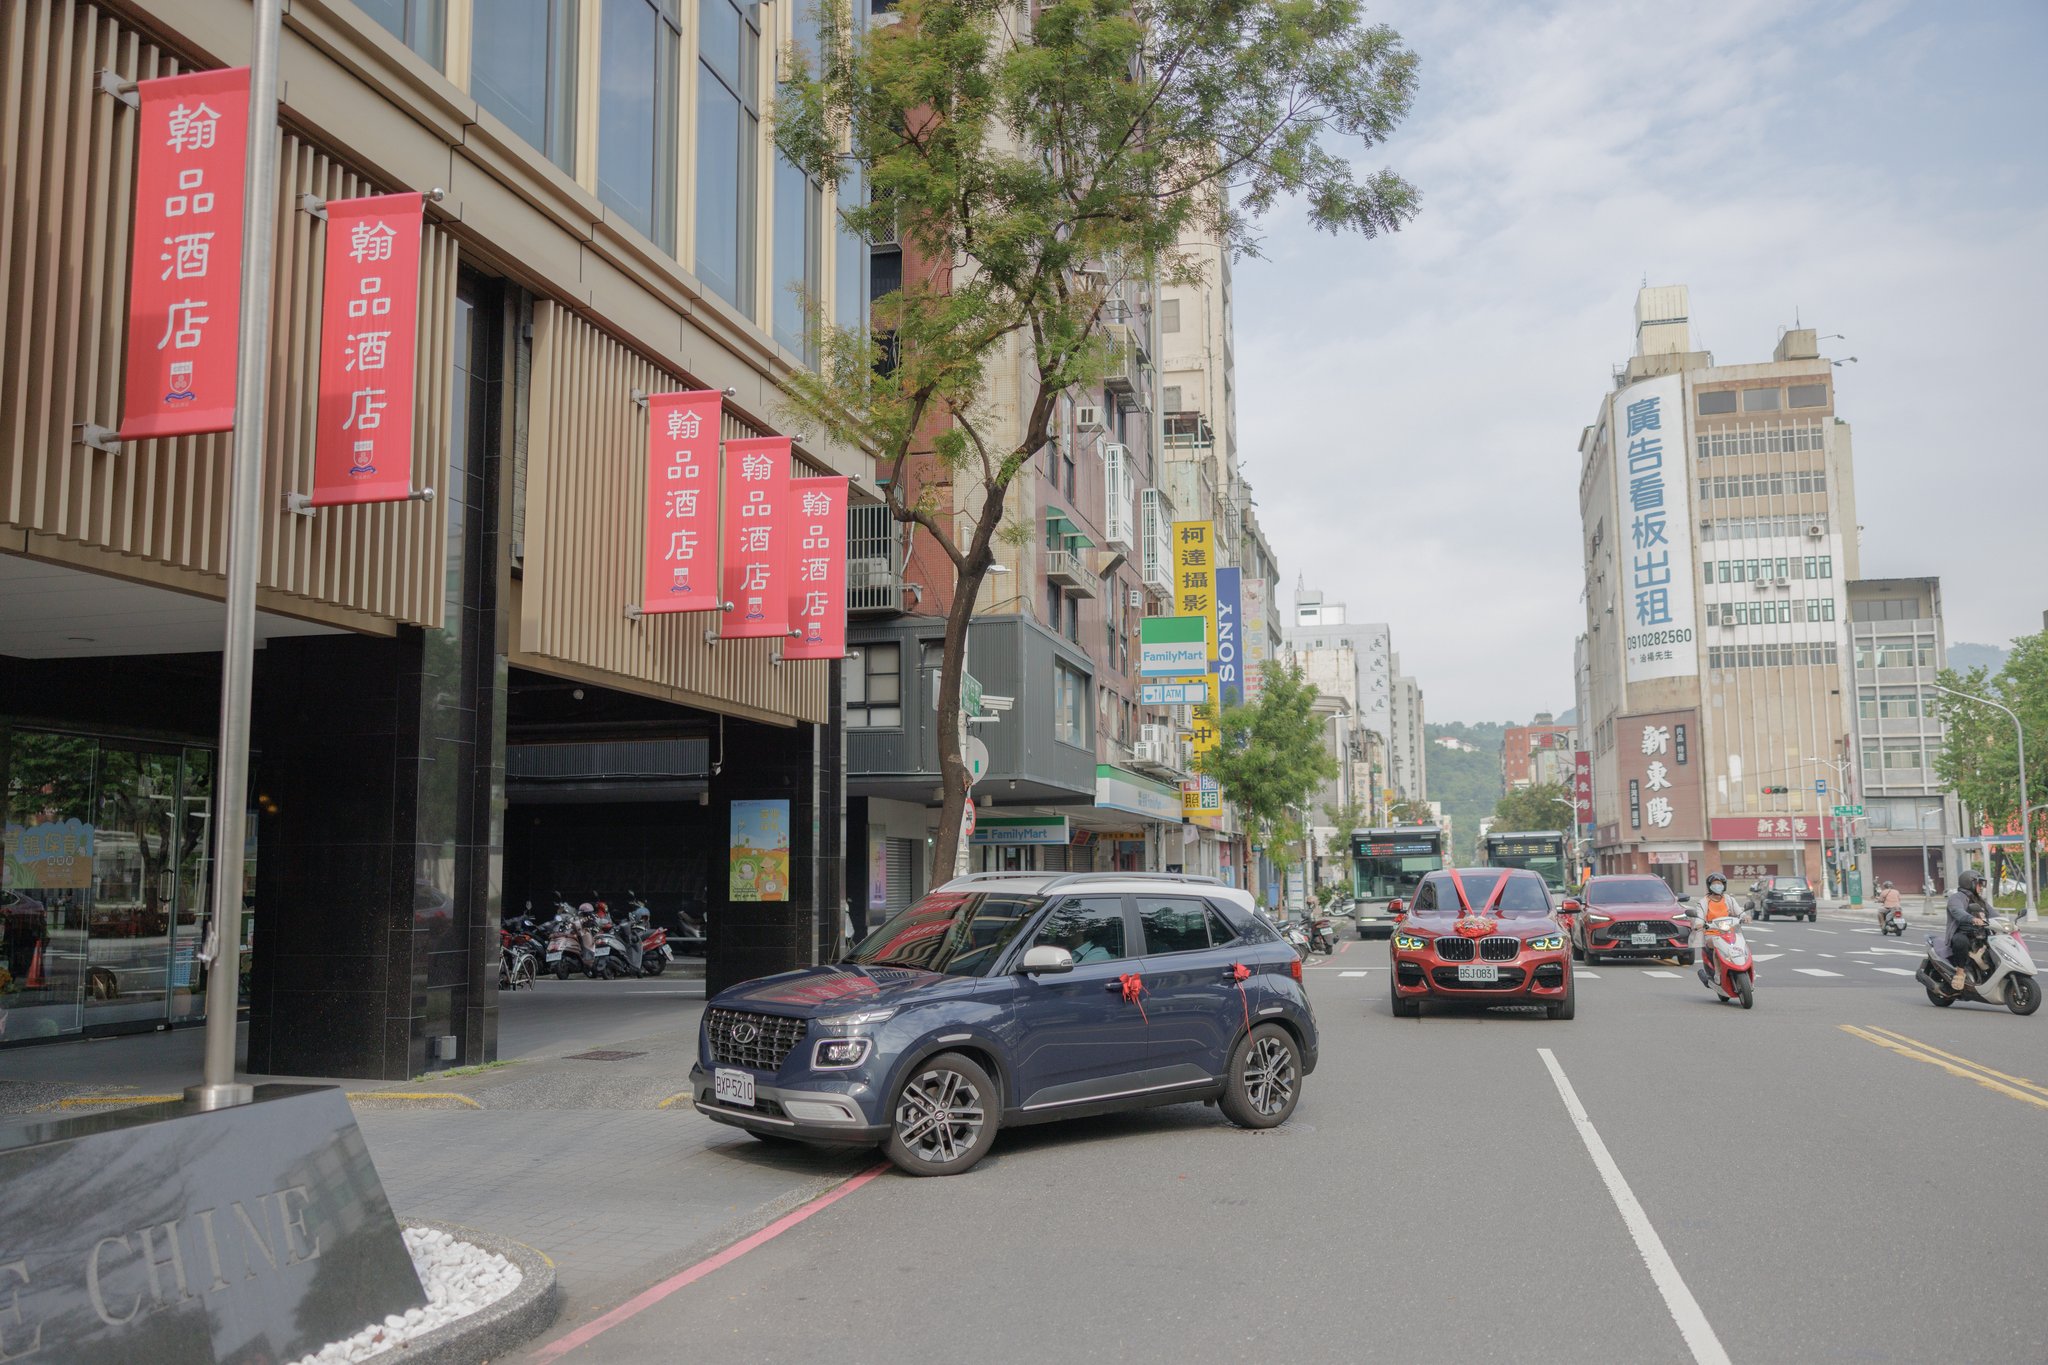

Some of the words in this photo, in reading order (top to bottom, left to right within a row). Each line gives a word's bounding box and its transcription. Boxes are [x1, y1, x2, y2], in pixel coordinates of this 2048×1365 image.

[157, 102, 222, 350] 翰品酒店
[342, 220, 397, 430] 翰品酒店
[664, 409, 702, 560] 翰品酒店
[740, 453, 774, 591] 翰品酒店
[1626, 396, 1673, 627] 廣告看板出租
[800, 491, 832, 617] 翰品酒店
[1180, 527, 1208, 612] 柯達攝影
[1143, 651, 1203, 663] FamilyMart
[1218, 600, 1235, 682] SONY
[1627, 628, 1692, 650] 0910282560
[1166, 689, 1181, 698] ATM
[1641, 725, 1673, 827] 新東陽
[1757, 819, 1807, 833] 新東陽
[991, 829, 1047, 840] FamilyMart
[86, 1184, 321, 1326] CHINE
